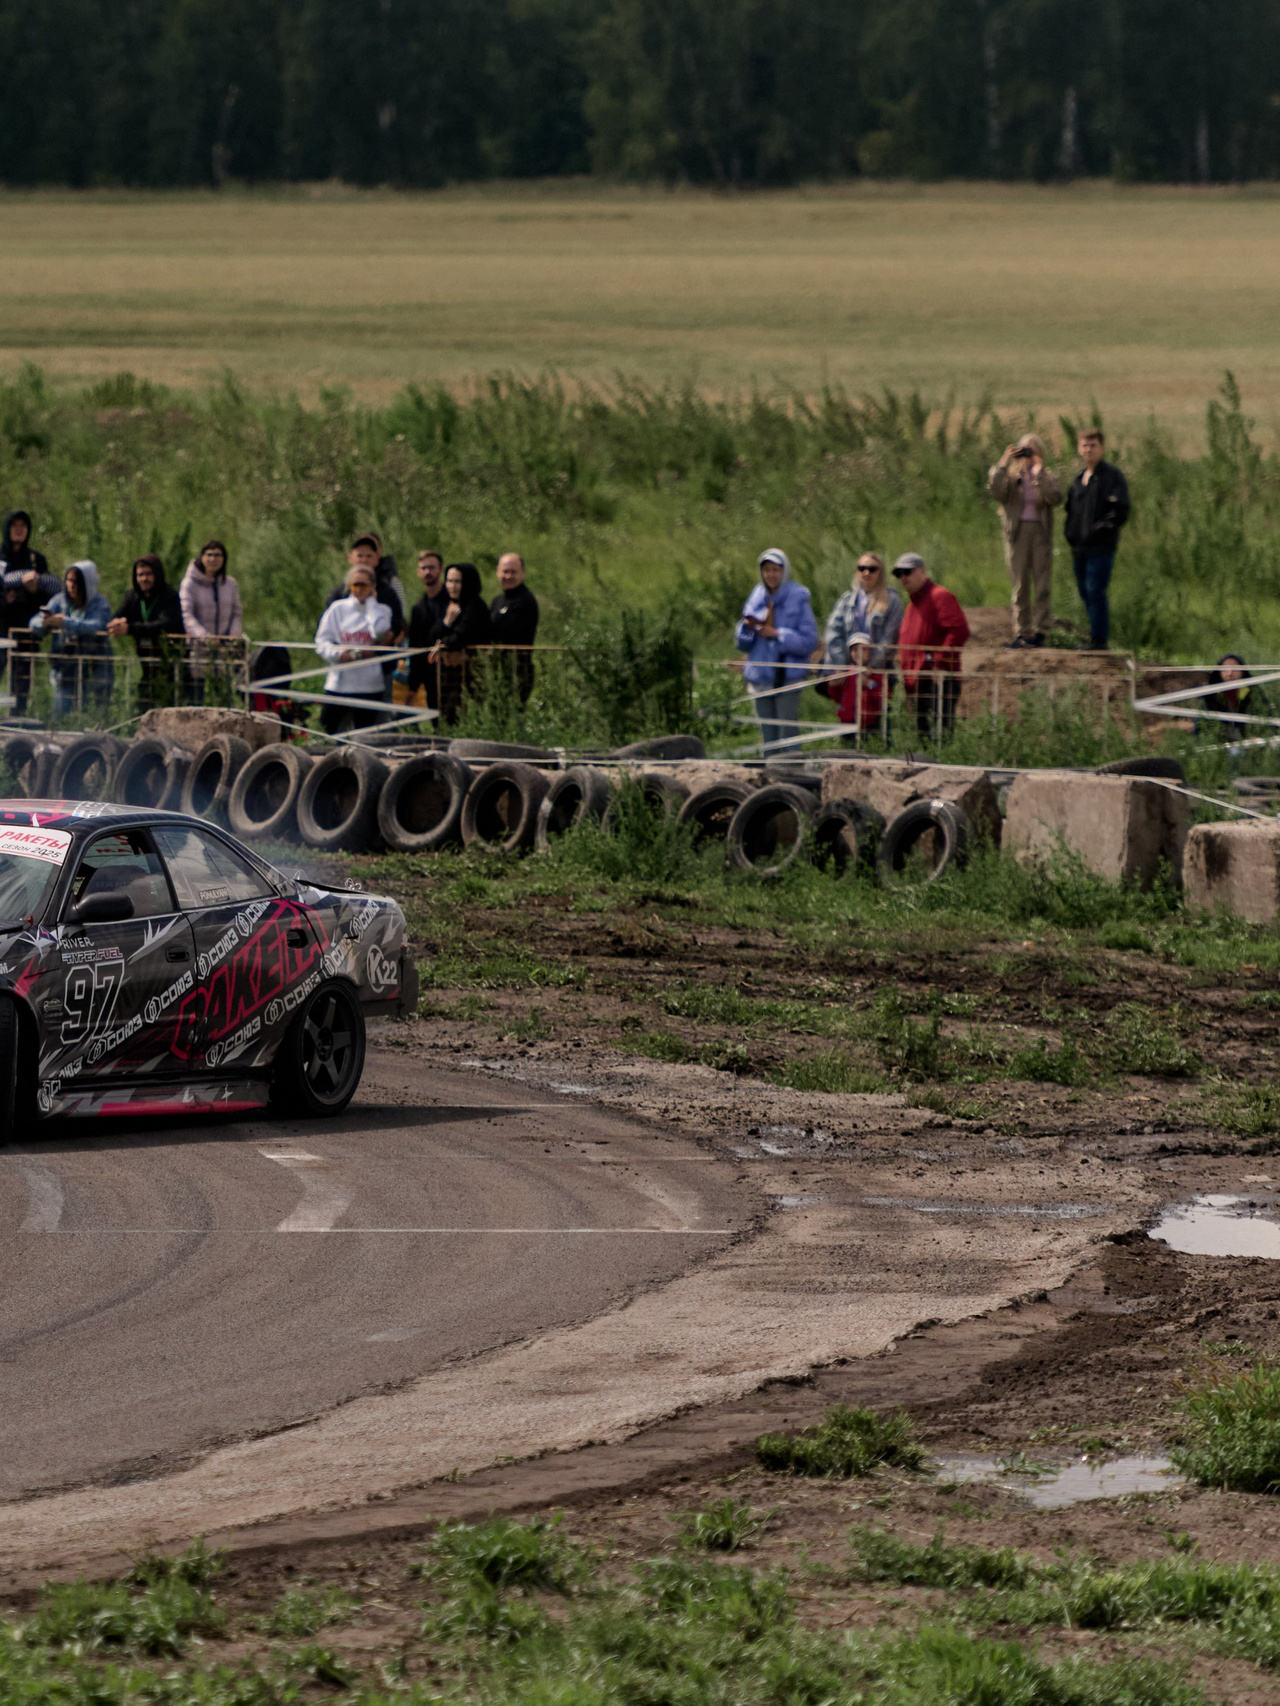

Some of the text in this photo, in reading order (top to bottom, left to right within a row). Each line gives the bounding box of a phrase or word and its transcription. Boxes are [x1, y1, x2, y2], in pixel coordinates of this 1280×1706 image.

[0, 831, 69, 849] РАКЕТЫ
[1, 843, 62, 859] СЕЗОН 2025
[61, 936, 95, 949] RIVER
[207, 928, 239, 966] СОЮЗ
[60, 959, 125, 1044] 97
[159, 970, 194, 1009] СОЮЗ
[107, 1013, 143, 1051] СОЮЗ
[223, 1016, 261, 1052] СОЮЗ
